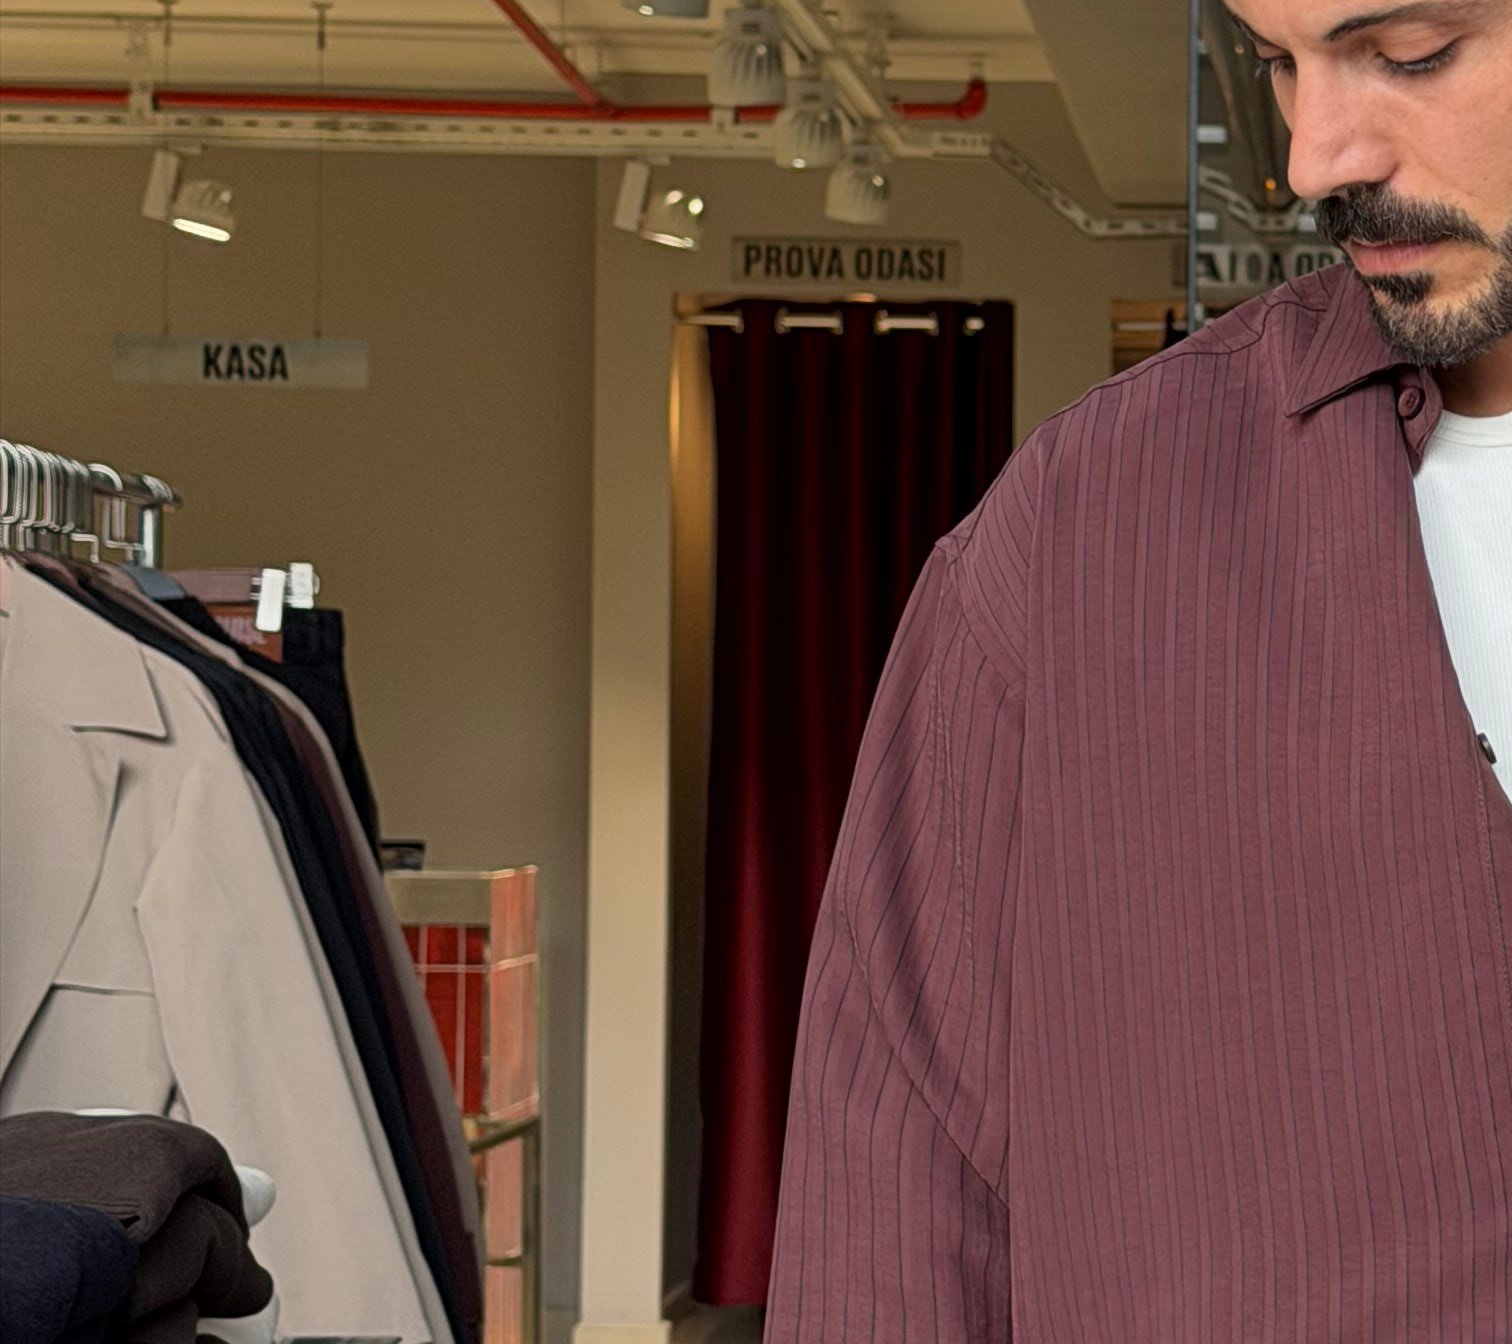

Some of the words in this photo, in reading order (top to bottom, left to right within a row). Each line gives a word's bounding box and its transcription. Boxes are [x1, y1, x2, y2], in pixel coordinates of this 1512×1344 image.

[742, 244, 845, 279] PROVA
[854, 246, 947, 282] ODASI
[202, 343, 290, 381] KASA
